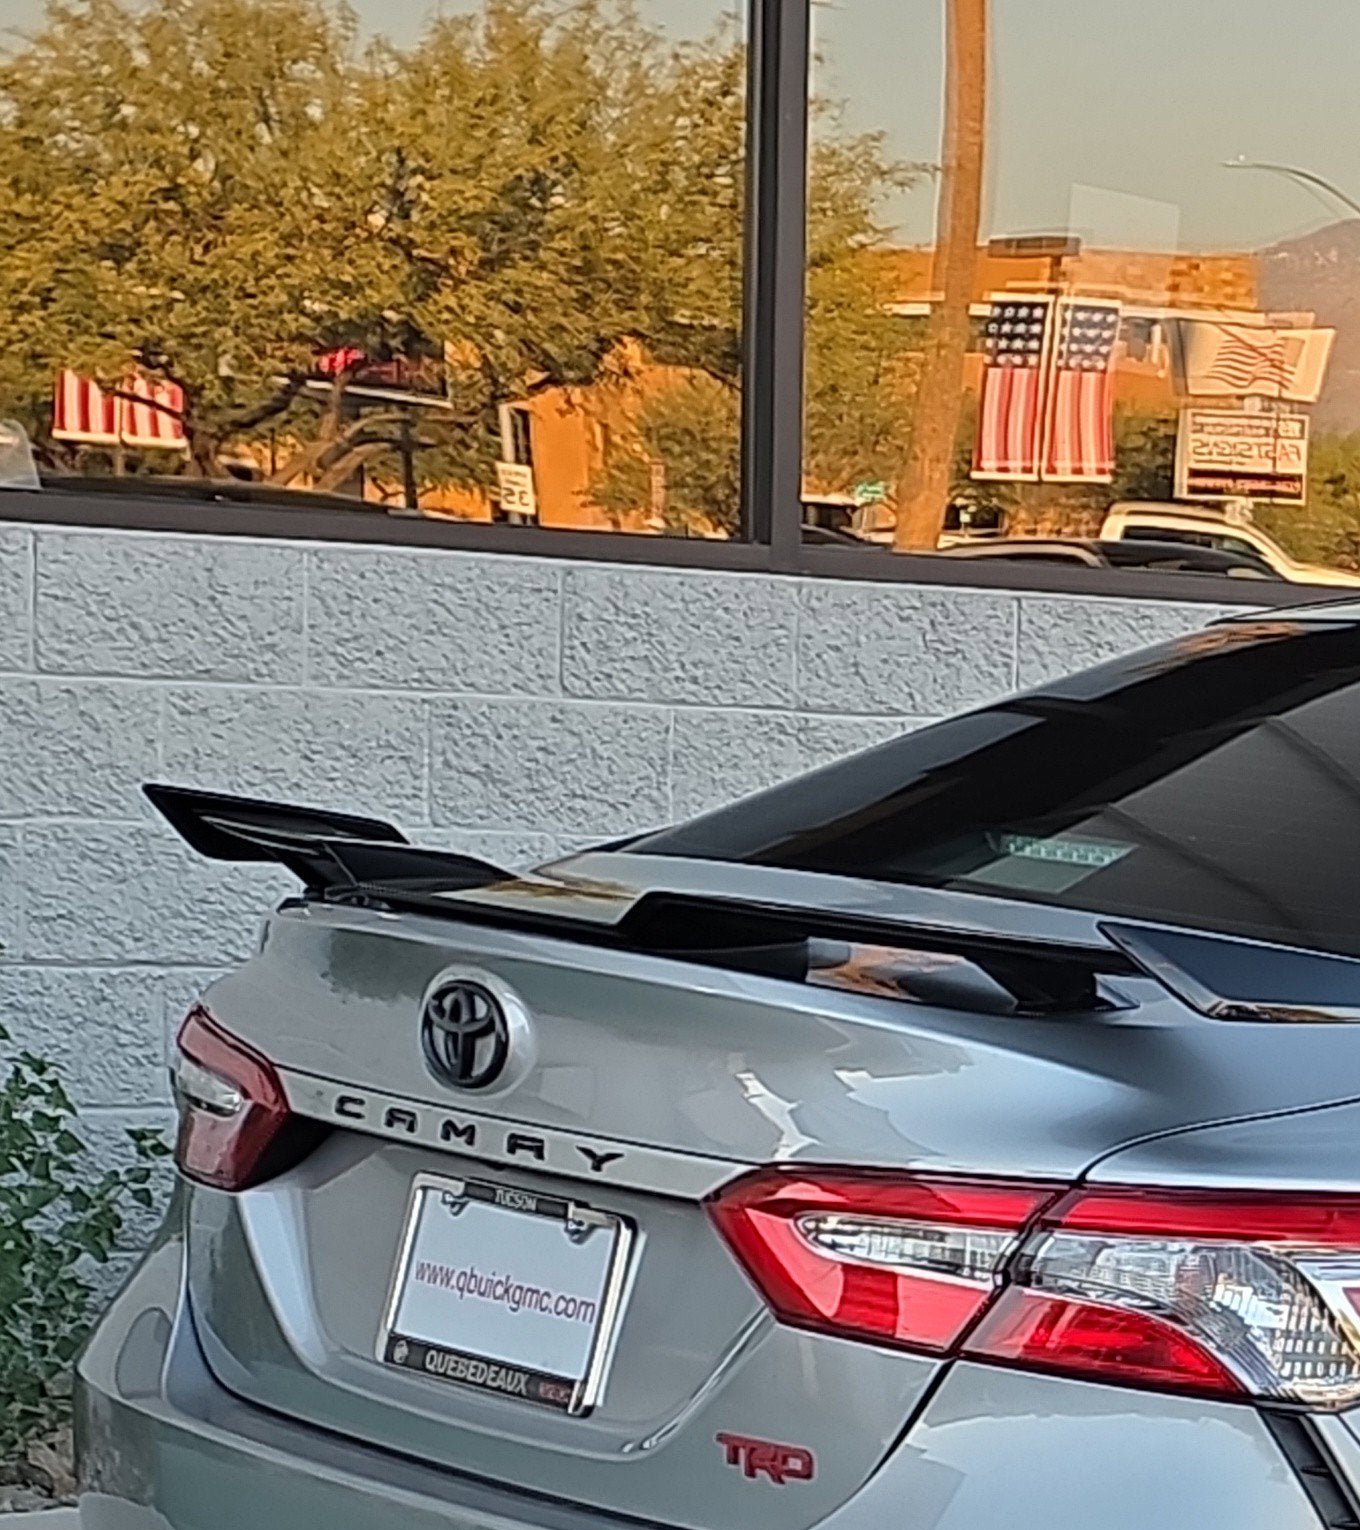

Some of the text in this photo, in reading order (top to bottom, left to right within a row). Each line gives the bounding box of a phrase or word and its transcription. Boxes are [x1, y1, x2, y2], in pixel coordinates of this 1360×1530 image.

[334, 1094, 625, 1172] CAMRY
[414, 1260, 597, 1324] www.qbuickgmc.com
[424, 1349, 530, 1396] QUEBEDEAUX
[715, 1431, 813, 1485] TRD
